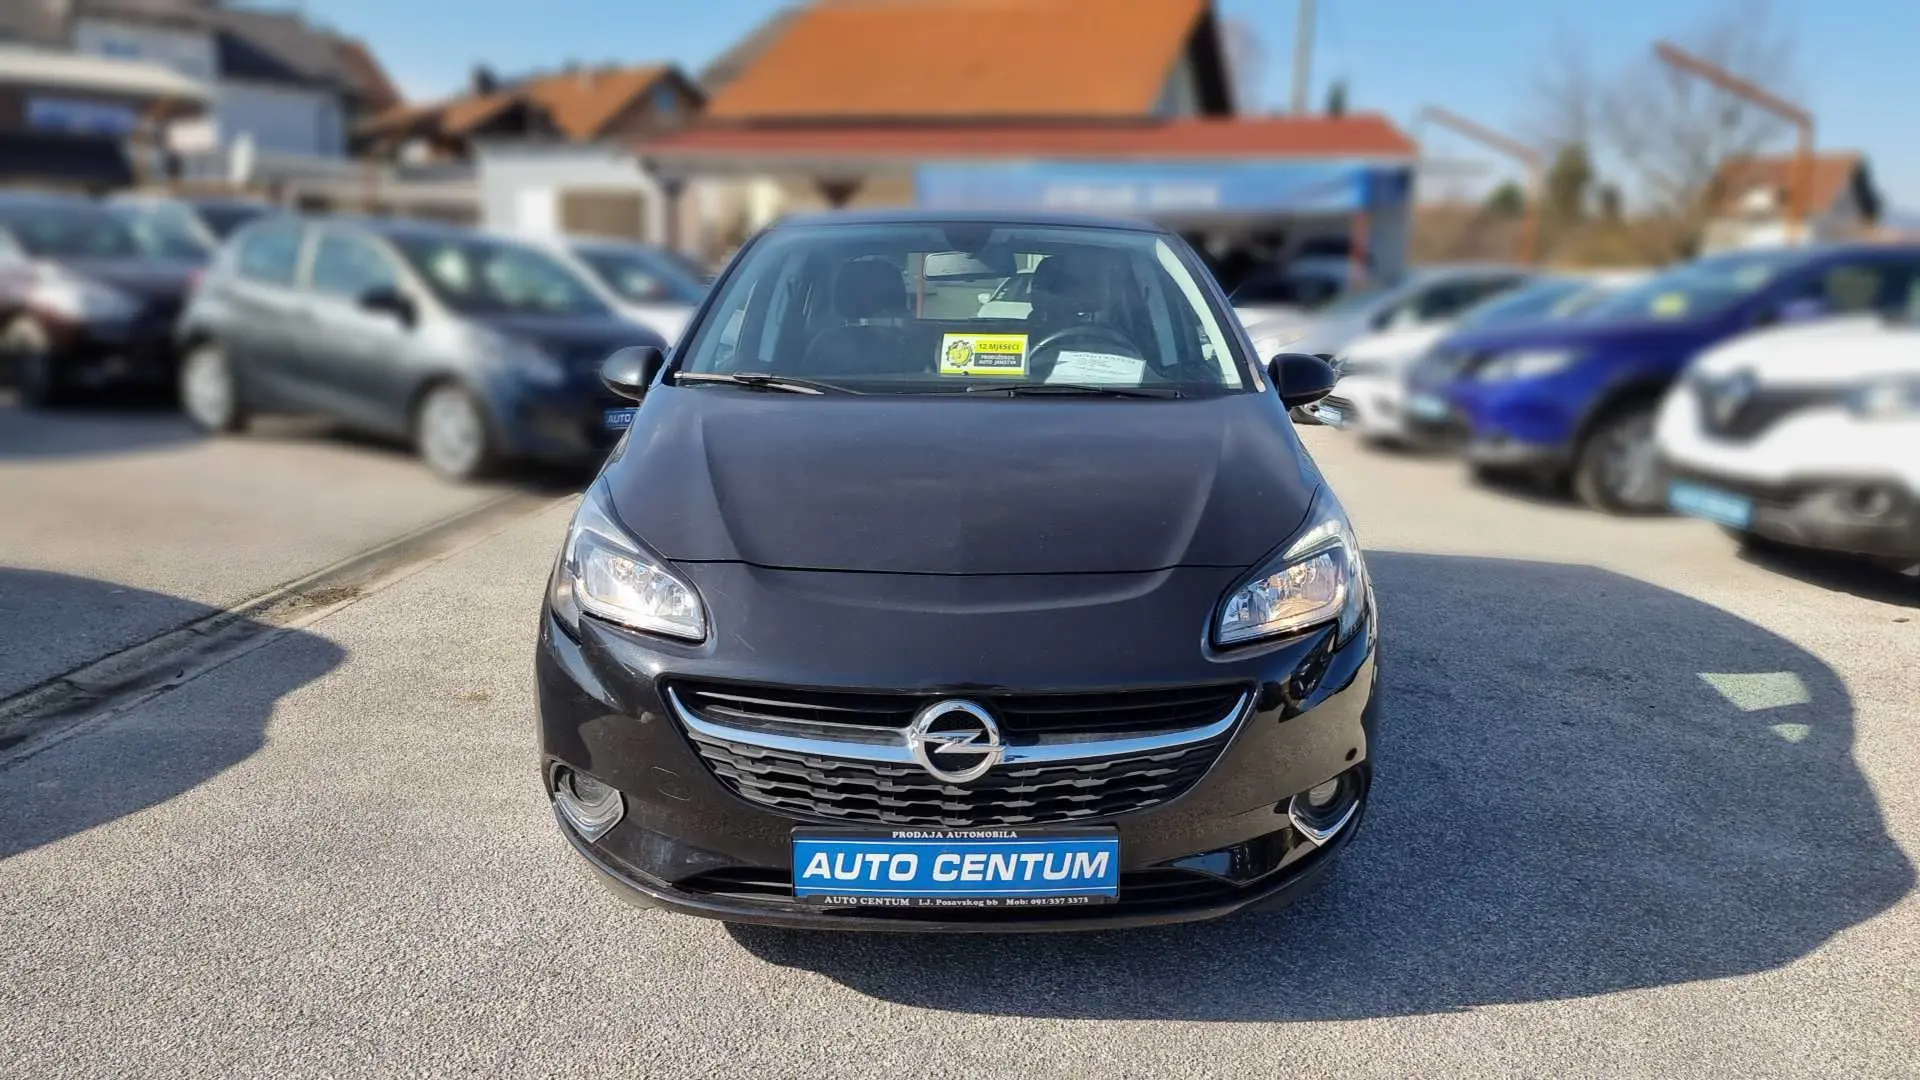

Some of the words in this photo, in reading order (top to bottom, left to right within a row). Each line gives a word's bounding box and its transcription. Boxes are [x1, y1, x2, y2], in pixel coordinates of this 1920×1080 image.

[607, 414, 631, 423] AUTO
[892, 831, 943, 839] PRODAJA
[802, 852, 919, 881] AUTO
[932, 851, 1110, 882] CENTUM
[824, 896, 857, 904] AUTO
[860, 897, 910, 906] CENTUM
[936, 899, 984, 907] Posavskog
[986, 898, 998, 906] bb
[1006, 898, 1028, 906] Mob:
